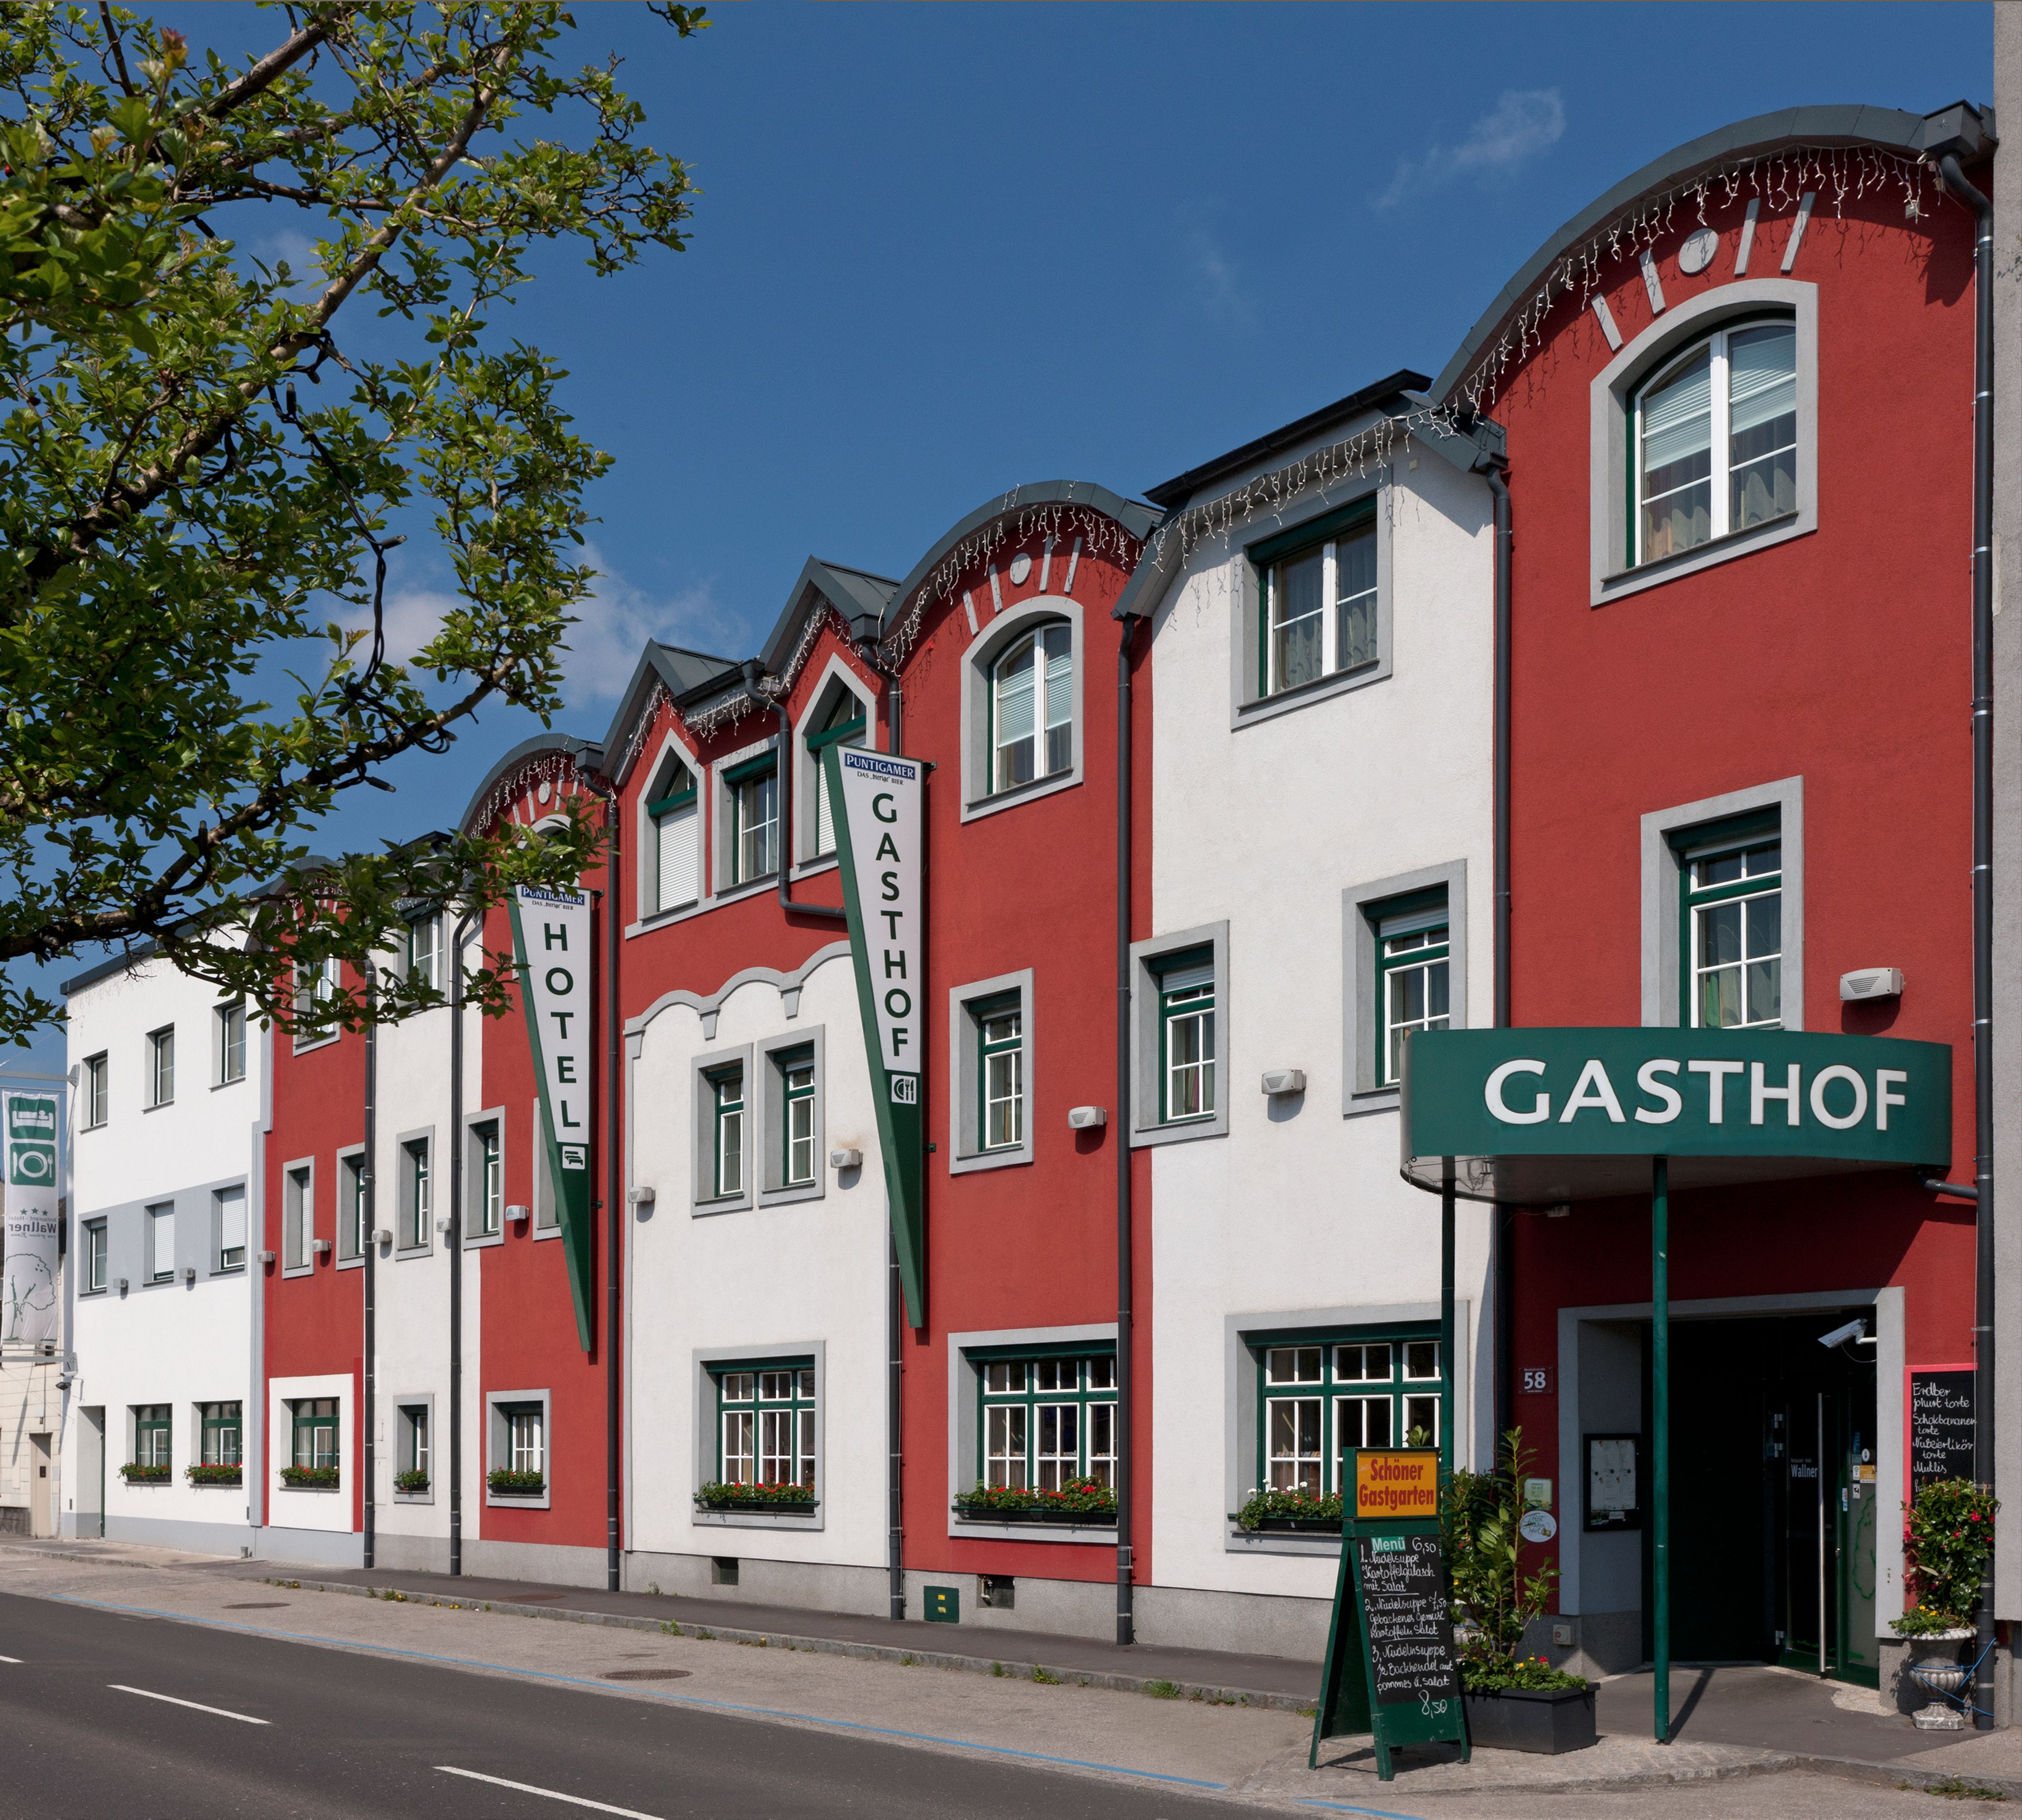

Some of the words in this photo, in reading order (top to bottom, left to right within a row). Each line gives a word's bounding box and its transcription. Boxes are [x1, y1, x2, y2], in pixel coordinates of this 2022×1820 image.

[846, 754, 914, 778] PUNTIGAMER
[857, 771, 869, 779] DAS
[871, 793, 911, 1057] GASTHOF
[544, 923, 581, 1129] HOTEL
[1484, 1058, 1908, 1131] GASTHOF
[1524, 1372, 1546, 1389] 58
[1913, 1382, 1951, 1397] Erdber
[1370, 1457, 1424, 1481] Schöner
[1791, 1463, 1818, 1478] Wallner
[1359, 1483, 1434, 1511] Gastgarten
[1372, 1537, 1406, 1551] Menü
[1412, 1537, 1437, 1555] 6,50
[1369, 1551, 1419, 1568] Nudelsuppe
[1363, 1579, 1380, 1591] mit
[1381, 1580, 1407, 1592] Salat
[1377, 1597, 1427, 1613] Nudelsuppe
[1429, 1591, 1447, 1611] 7,50
[1369, 1612, 1415, 1631] Gebackenes
[1418, 1690, 1448, 1719] 8,50
